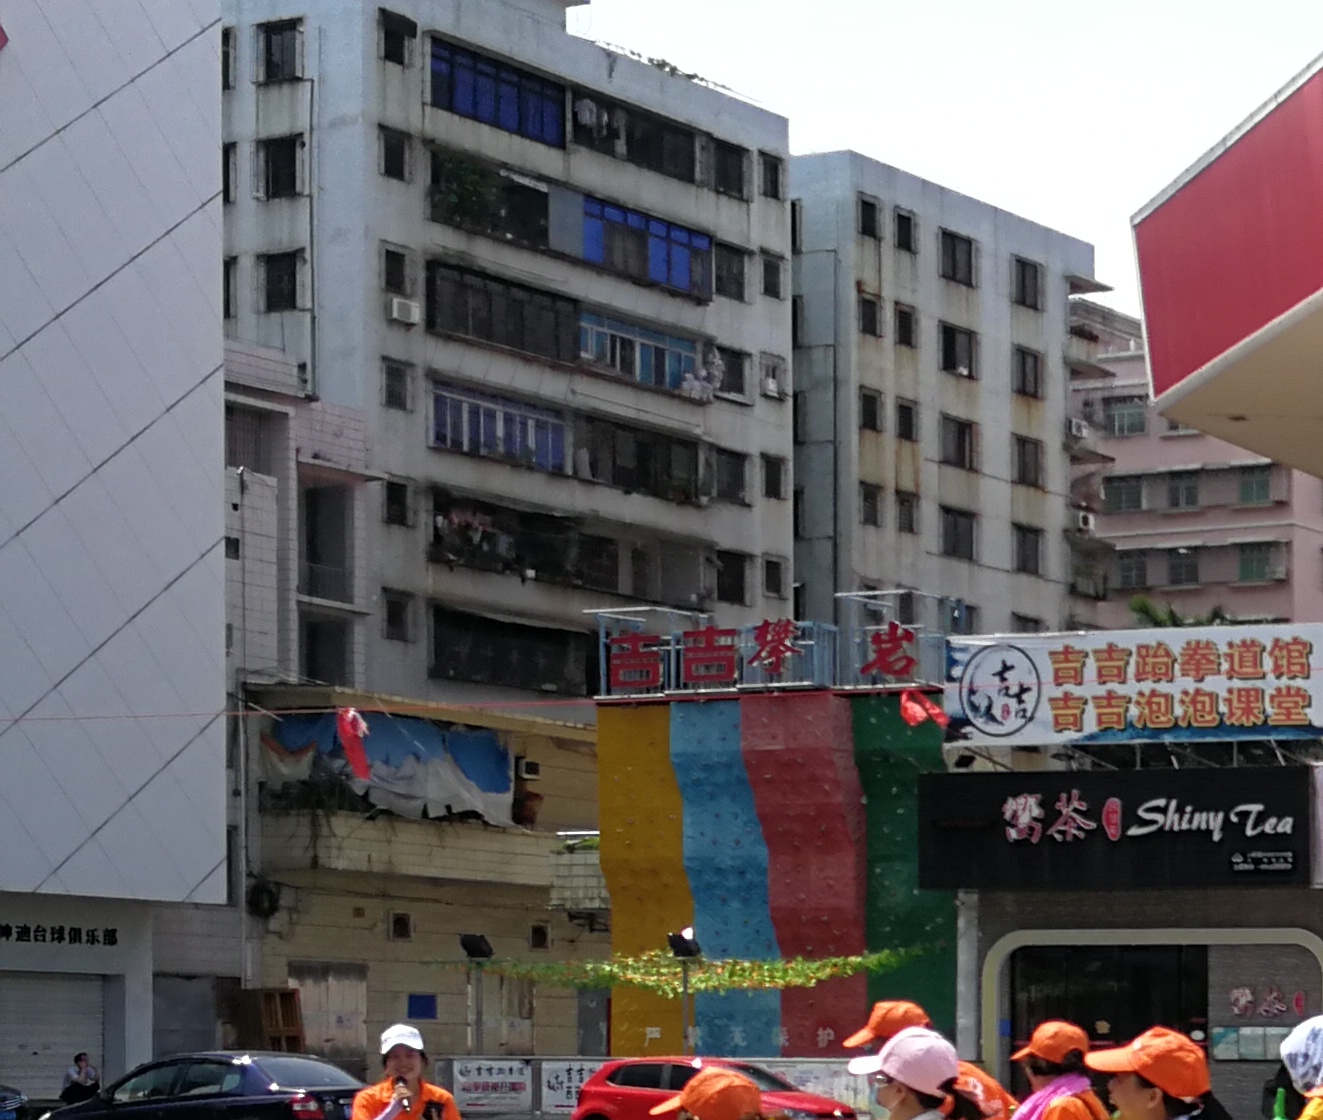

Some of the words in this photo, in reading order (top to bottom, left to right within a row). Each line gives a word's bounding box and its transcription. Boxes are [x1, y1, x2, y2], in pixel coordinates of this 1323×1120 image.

[609, 617, 924, 688] 吉吉攀岩
[1048, 637, 1313, 686] 吉吉跆拳道馆
[1048, 685, 1312, 732] 吉吉泡泡课堂
[1126, 798, 1224, 842] Shiny
[1230, 803, 1295, 837] Tea
